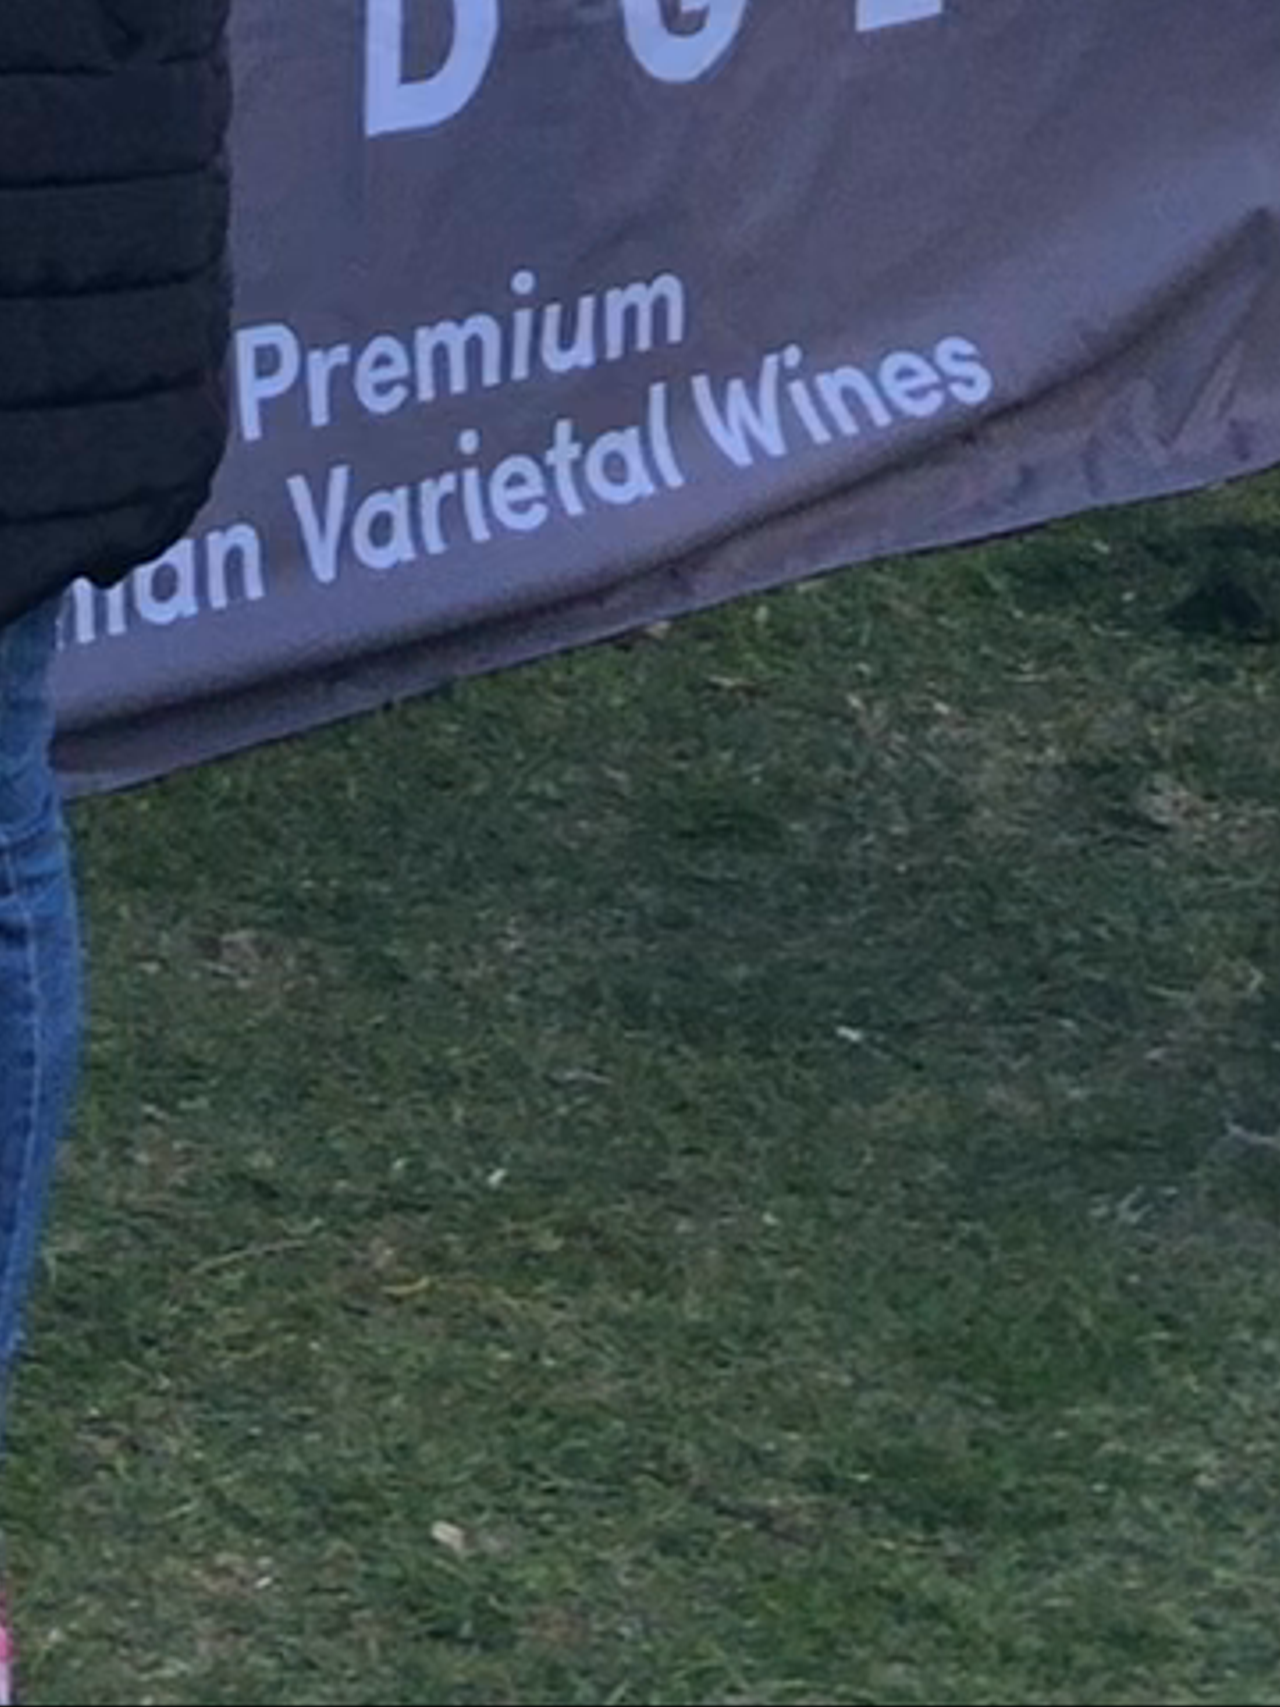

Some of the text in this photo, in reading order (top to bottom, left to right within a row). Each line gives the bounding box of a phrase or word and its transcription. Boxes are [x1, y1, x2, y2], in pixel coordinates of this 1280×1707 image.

[236, 270, 686, 441] Premium
[286, 388, 685, 583] Varietal
[688, 333, 992, 467] Wines
